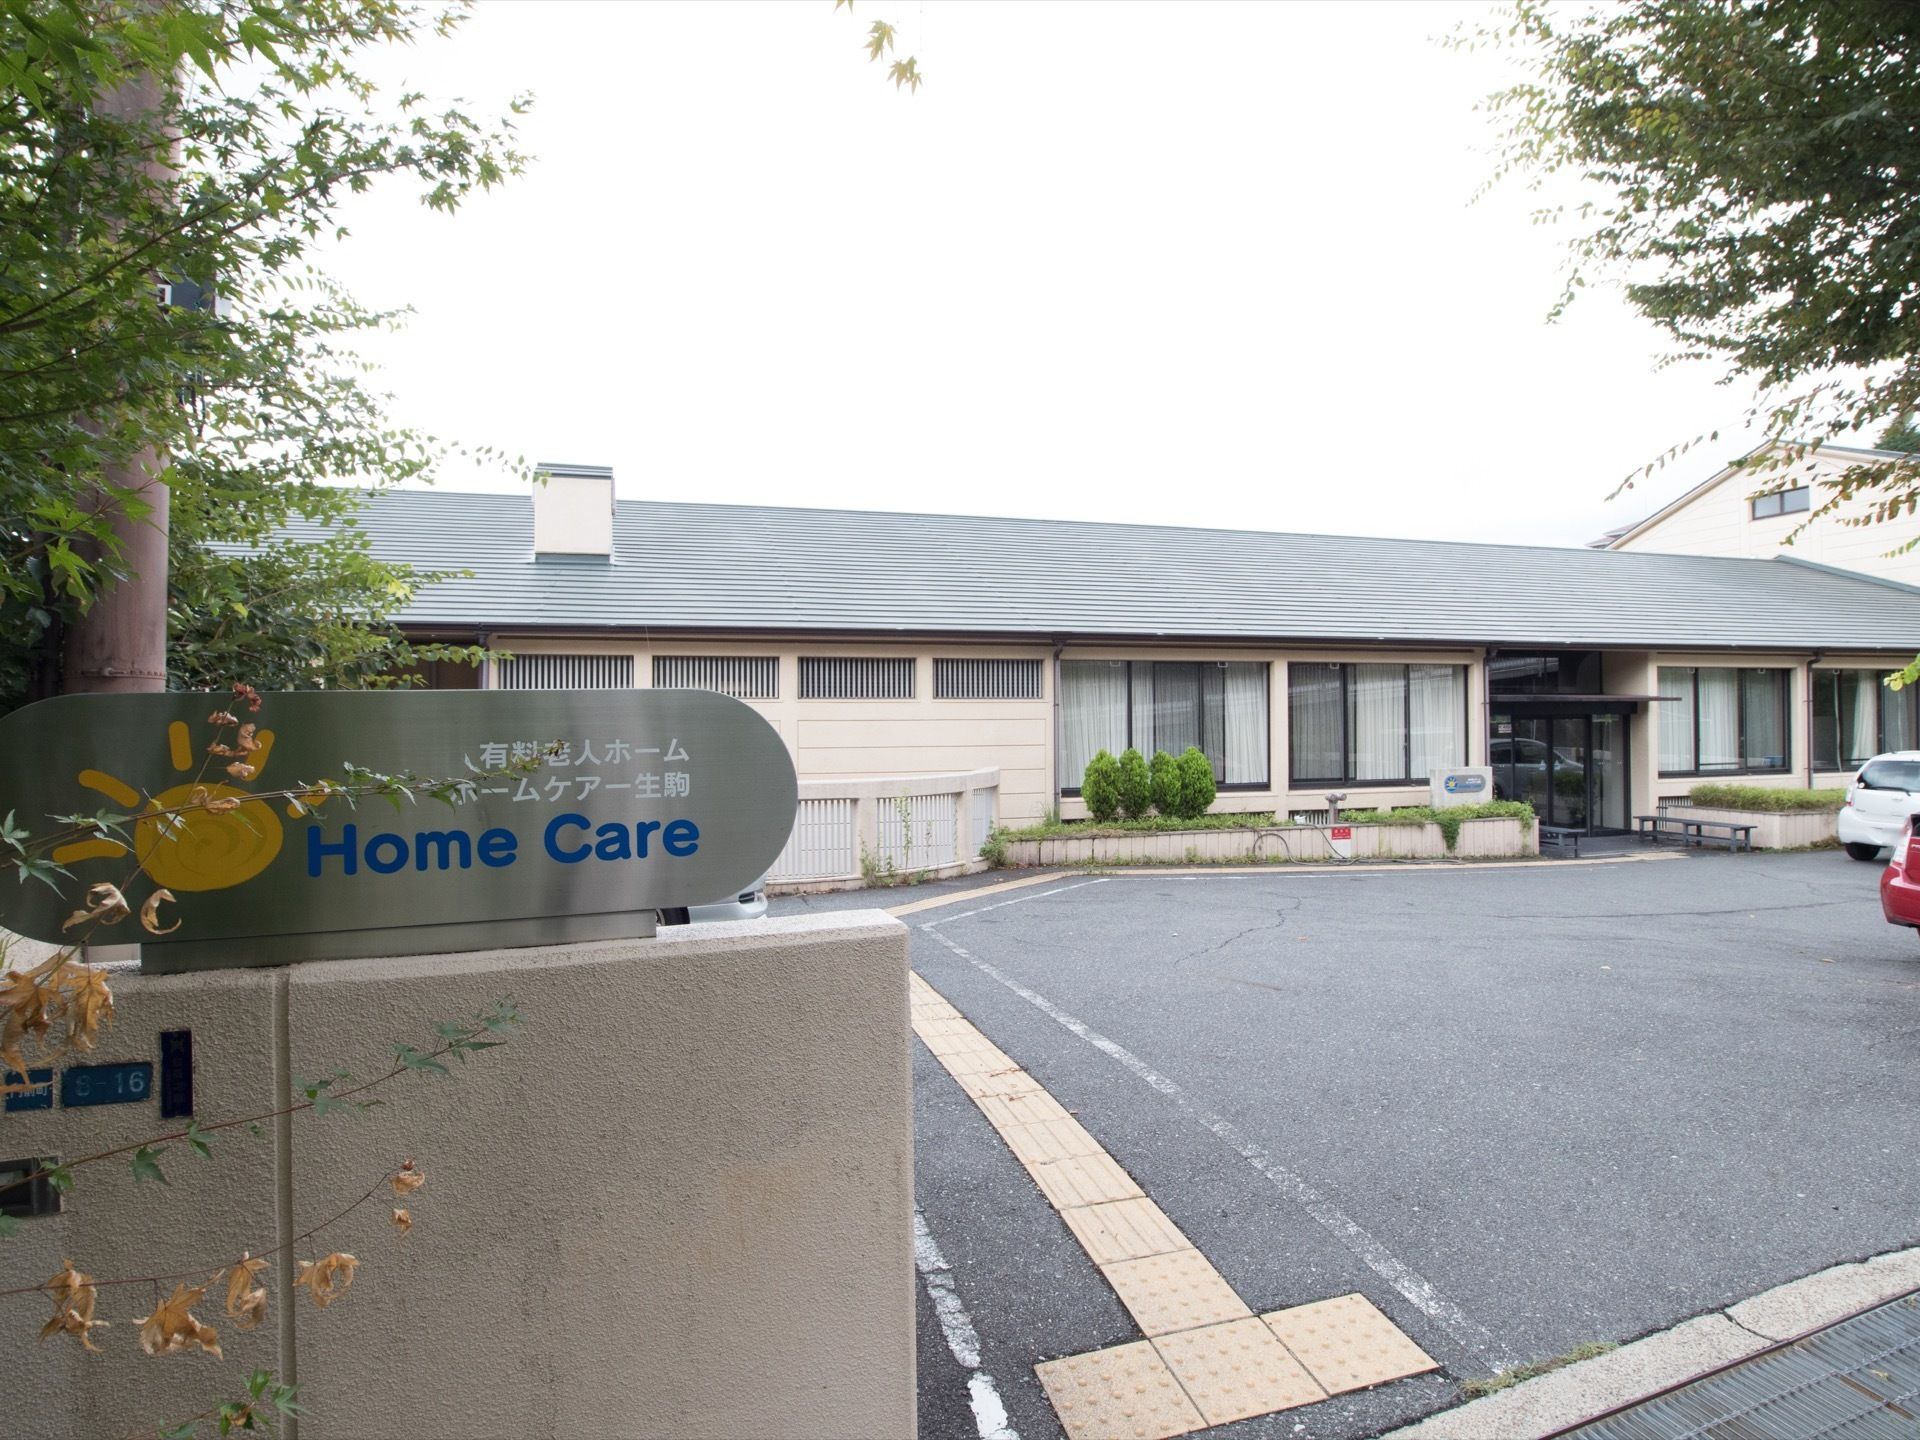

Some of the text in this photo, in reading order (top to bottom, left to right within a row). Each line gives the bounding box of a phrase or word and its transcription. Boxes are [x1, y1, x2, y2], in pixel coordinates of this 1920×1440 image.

[479, 738, 690, 769] 有料老人ホーム
[307, 813, 700, 877] Home Care
